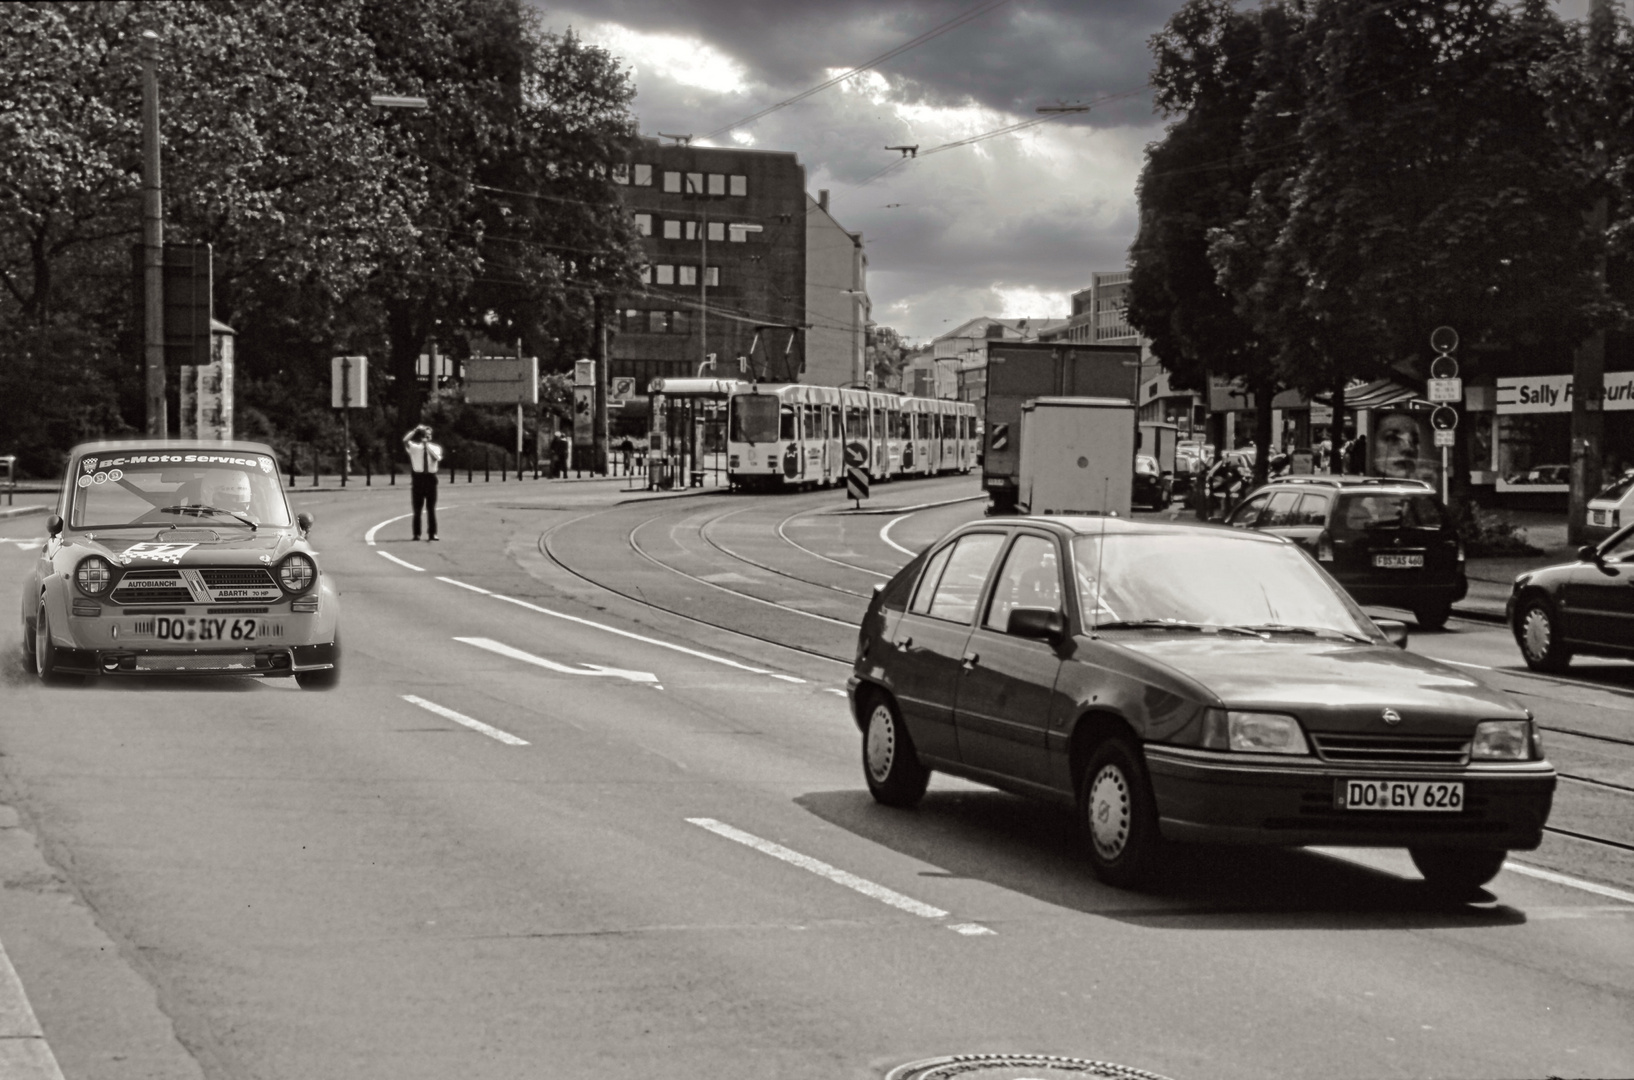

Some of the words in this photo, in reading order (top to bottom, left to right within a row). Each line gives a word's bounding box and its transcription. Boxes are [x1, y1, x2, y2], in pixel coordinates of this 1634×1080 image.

[1519, 384, 1559, 407] Sally
[99, 455, 182, 468] BC-Moto
[184, 454, 257, 467] Service
[128, 580, 177, 588] AUTOBIANCHI
[157, 617, 185, 640] DO
[230, 618, 257, 641] 62
[1349, 783, 1378, 807] DO
[1391, 784, 1419, 807] GY
[1423, 785, 1461, 808] 626
